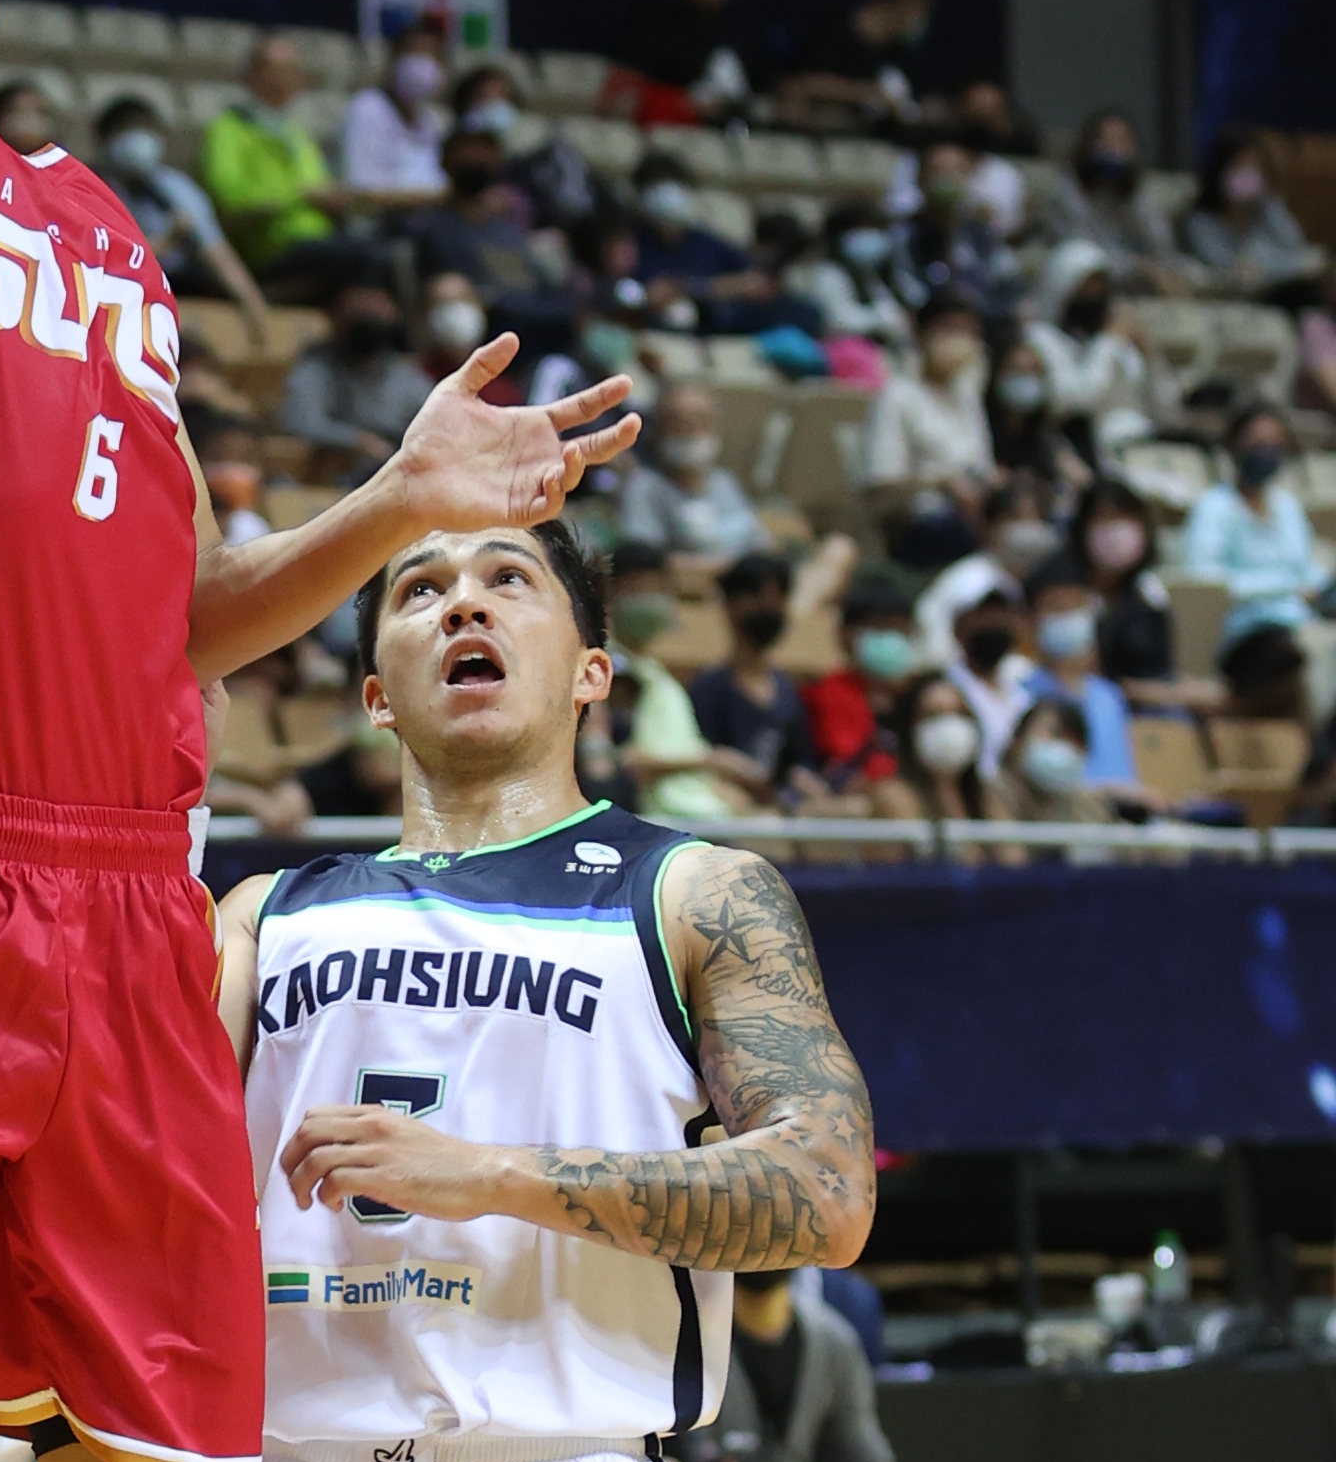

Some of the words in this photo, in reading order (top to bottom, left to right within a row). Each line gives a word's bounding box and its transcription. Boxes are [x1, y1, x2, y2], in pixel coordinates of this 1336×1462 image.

[72, 412, 124, 523] 6
[257, 946, 604, 1035] KAOHSIUNG
[324, 1268, 474, 1306] FamilyMart
